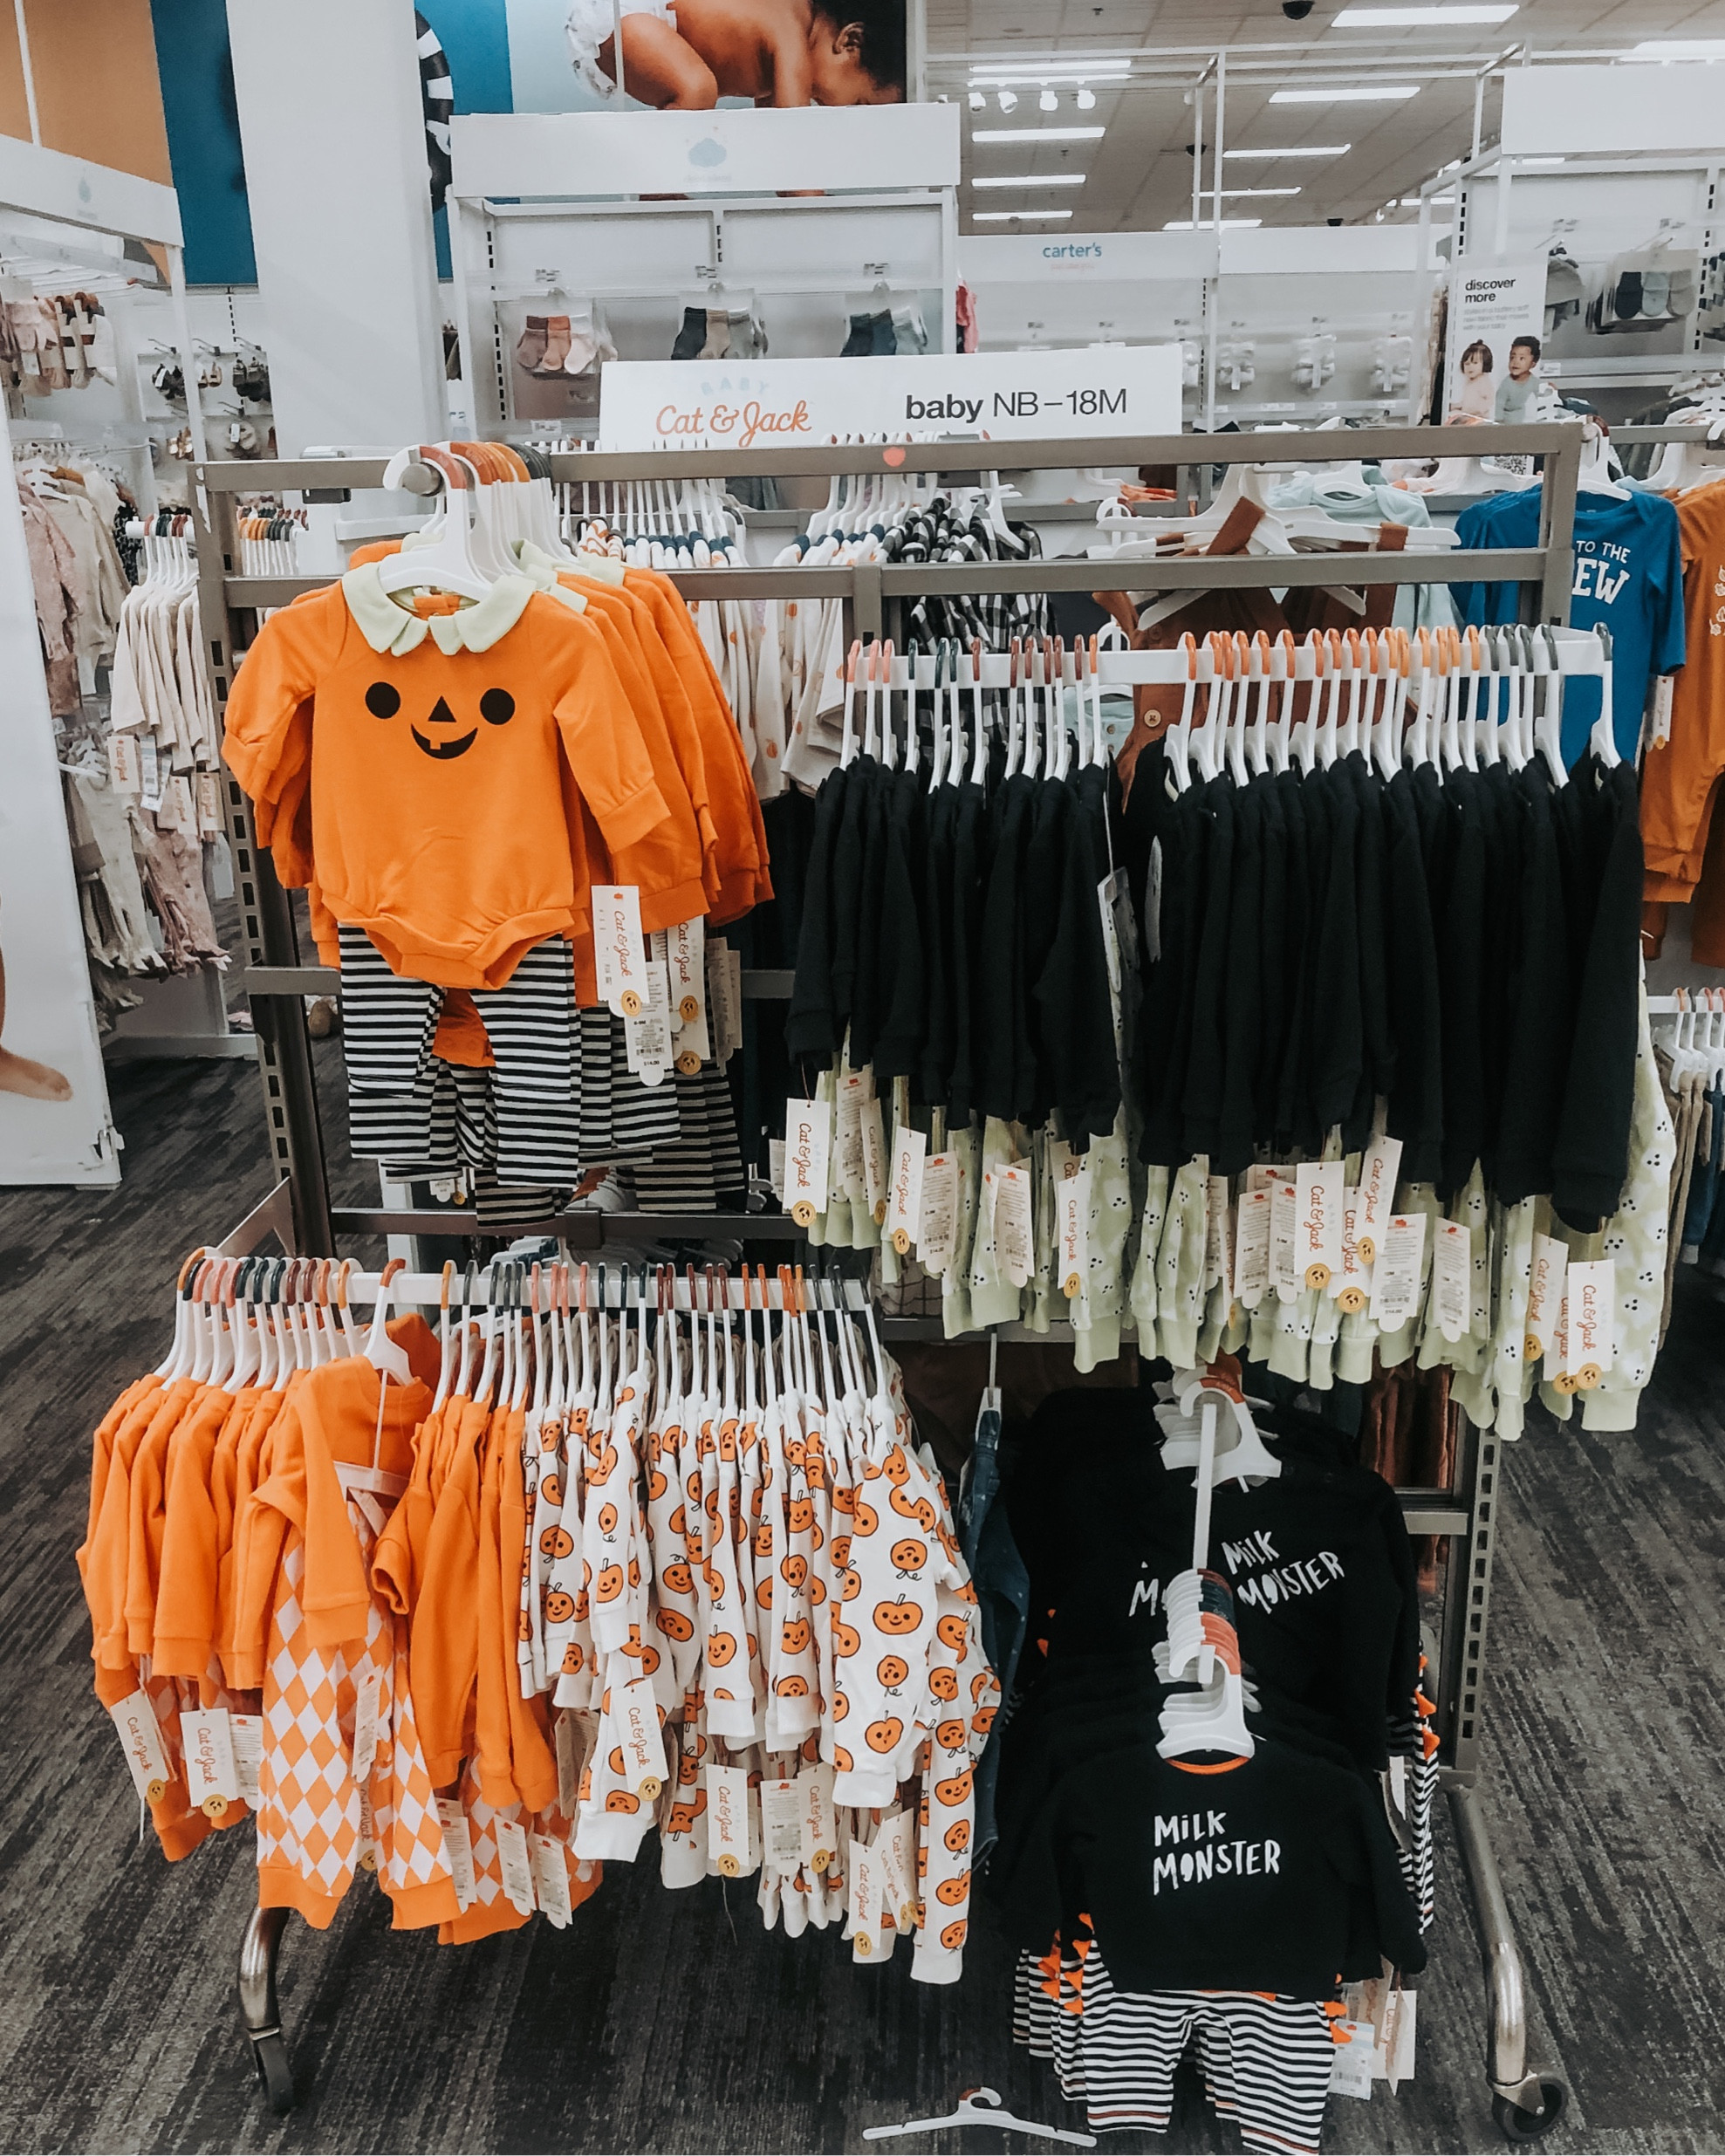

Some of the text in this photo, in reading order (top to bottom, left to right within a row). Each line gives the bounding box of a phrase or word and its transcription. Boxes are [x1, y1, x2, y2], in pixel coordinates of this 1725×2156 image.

[1043, 242, 1102, 258] carter's
[1465, 279, 1516, 291] discover
[1465, 292, 1496, 303] more
[656, 400, 812, 448] Cat & Jack
[906, 394, 984, 424] baby
[1576, 540, 1631, 564] TO THE
[1571, 557, 1631, 605] EW
[613, 910, 633, 977] Cat & Jack
[674, 922, 691, 985] Cat & Jack
[792, 1123, 811, 1188] Cat & Jack
[1064, 1162, 1074, 1180] Ca
[895, 1152, 911, 1215] Cat & Jack
[1364, 1158, 1384, 1225] Cat & Jack
[1303, 1185, 1325, 1252] Cat & Jack
[1537, 1258, 1550, 1280] Cat
[1576, 1284, 1597, 1352] Cat & Jack
[1237, 1550, 1345, 1614] MONSTER
[127, 1716, 140, 1737] Cat
[628, 1707, 651, 1769] Cat & Jack
[132, 1745, 153, 1774] Jack
[194, 1727, 218, 1785] Cat & Jack
[714, 1785, 734, 1843] Cat & Jack
[810, 1785, 820, 1805] Cat
[859, 1863, 870, 1883] Cat
[1153, 1838, 1281, 1896] MONSTER
[854, 1890, 870, 1921] Jack
